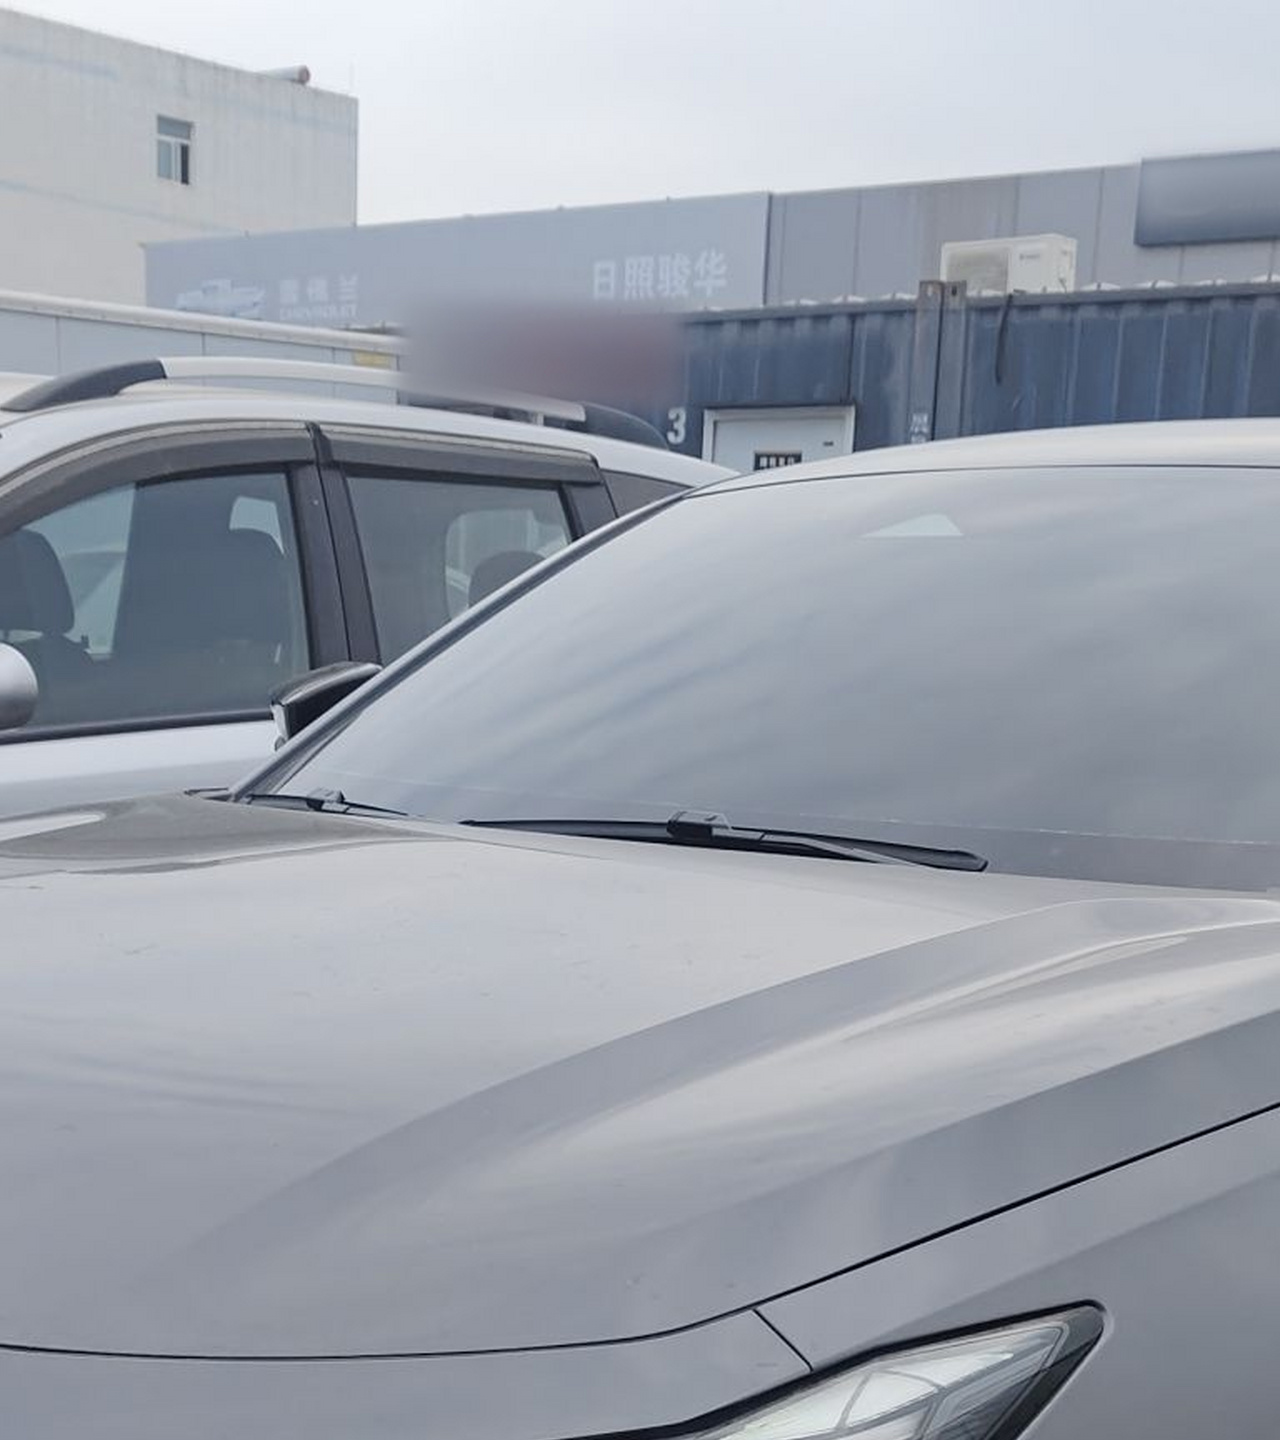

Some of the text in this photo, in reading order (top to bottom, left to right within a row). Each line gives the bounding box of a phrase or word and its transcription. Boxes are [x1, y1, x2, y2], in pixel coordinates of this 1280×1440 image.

[592, 248, 728, 300] 日照骏华
[666, 407, 686, 445] 3
